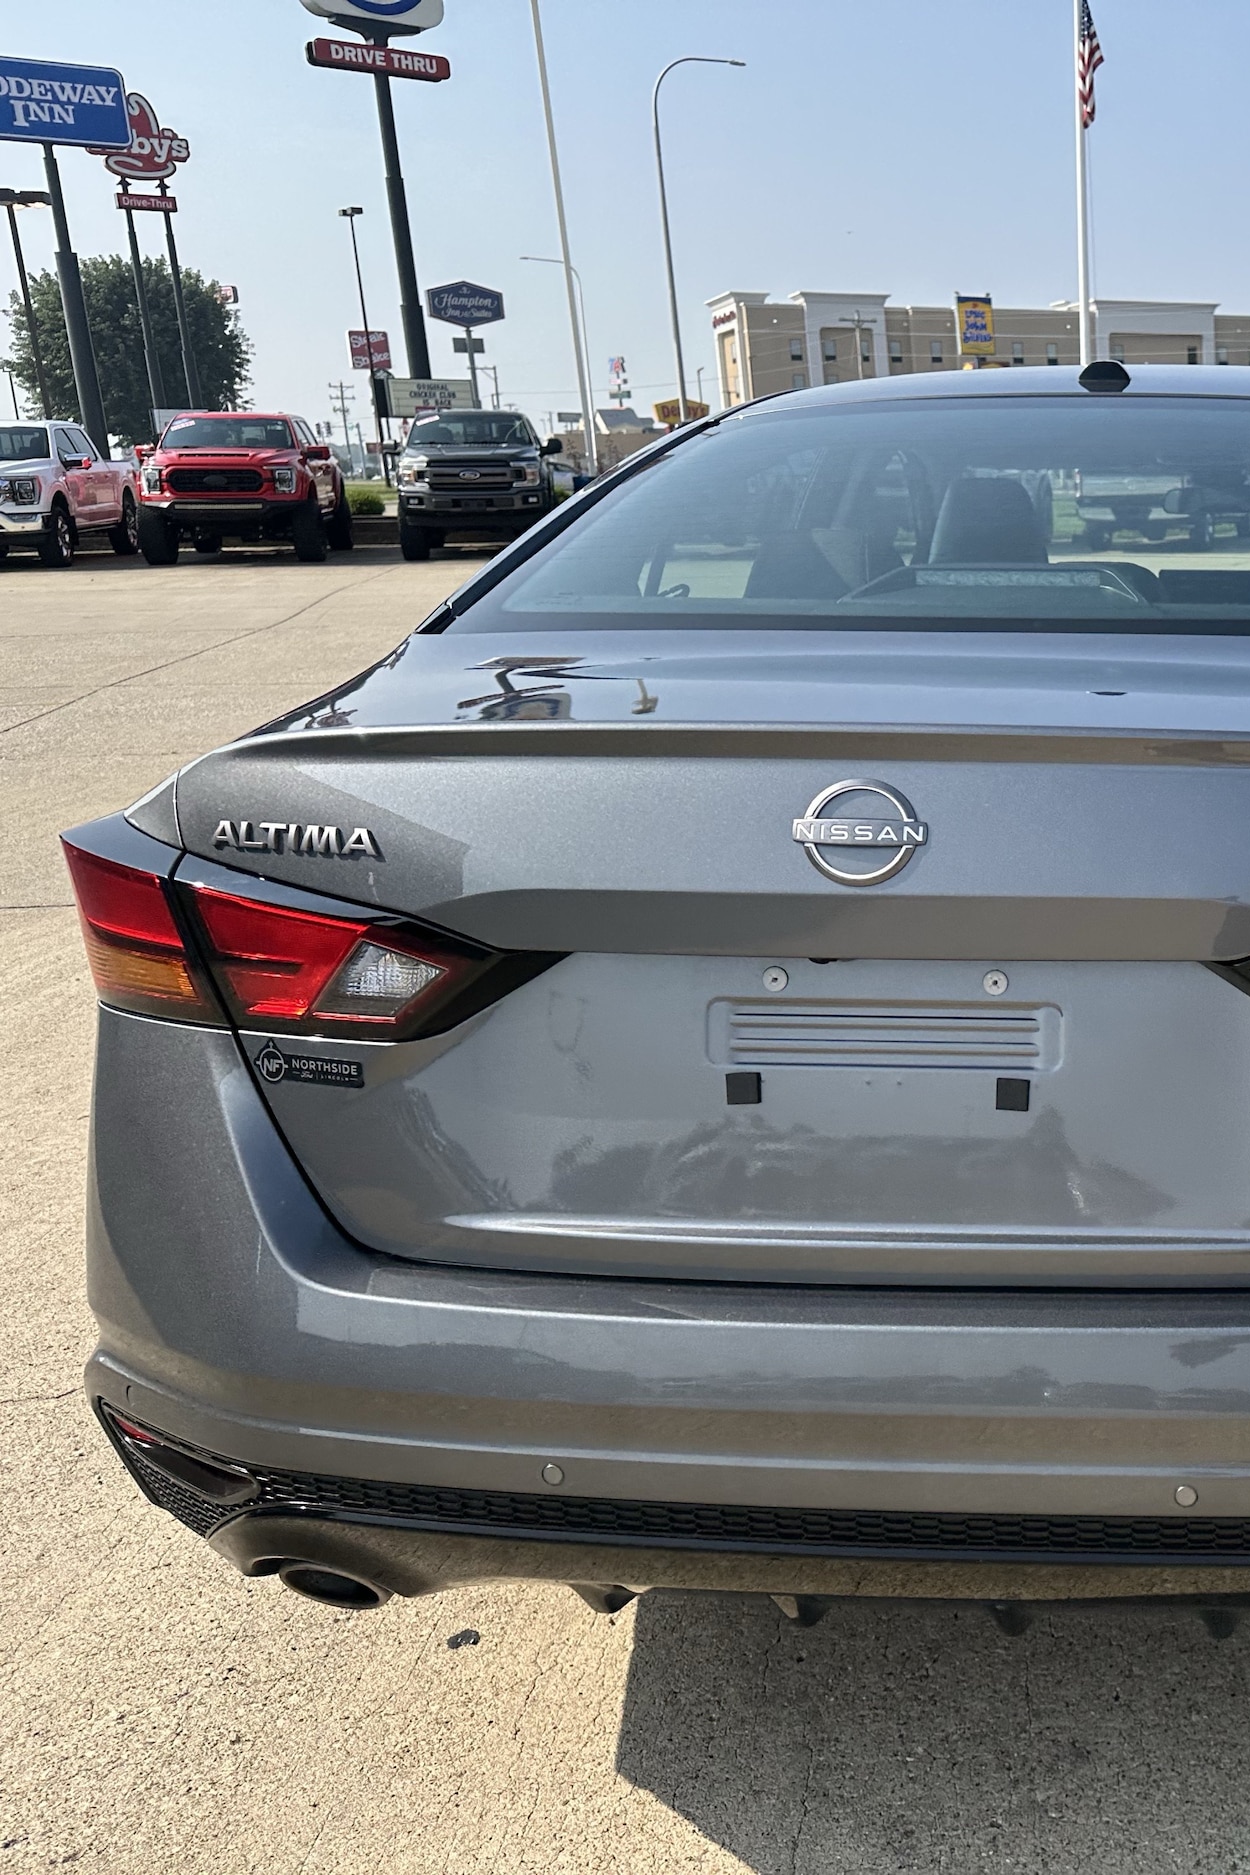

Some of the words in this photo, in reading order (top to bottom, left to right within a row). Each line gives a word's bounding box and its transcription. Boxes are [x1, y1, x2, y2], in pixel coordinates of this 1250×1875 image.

[330, 43, 387, 66] DRIVE
[390, 53, 437, 74] THRU
[9, 100, 75, 127] INN
[122, 196, 173, 209] Drive-Thru
[434, 293, 498, 309] Hampton
[211, 820, 382, 859] ALTIMA
[795, 822, 924, 842] NISSAN
[291, 1058, 358, 1075] NORTHSIDE
